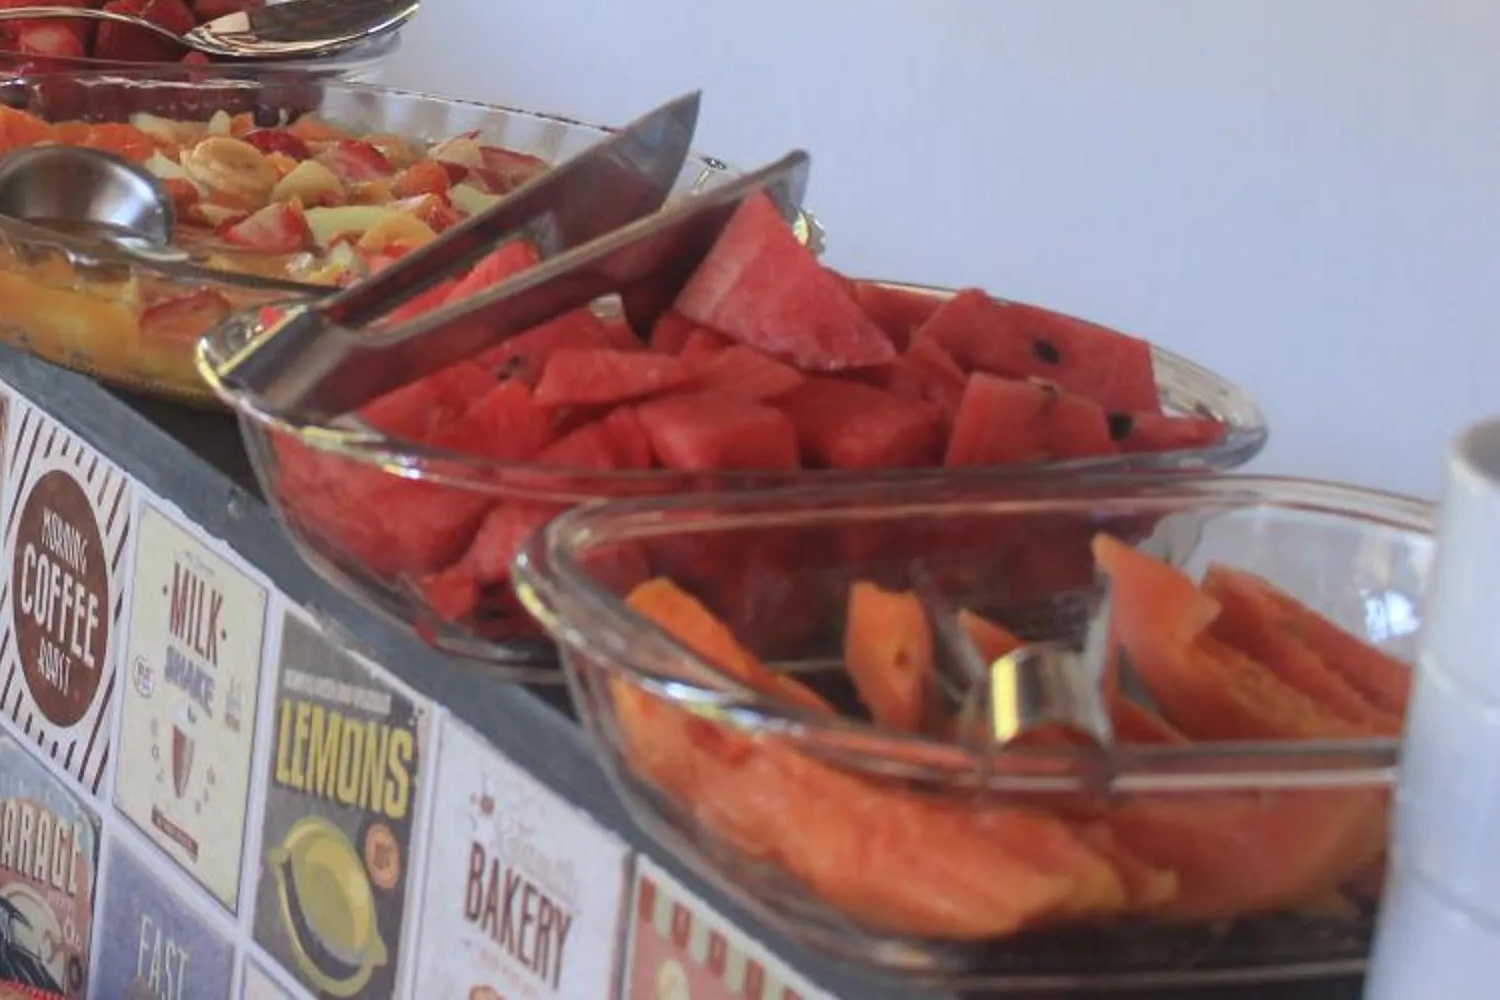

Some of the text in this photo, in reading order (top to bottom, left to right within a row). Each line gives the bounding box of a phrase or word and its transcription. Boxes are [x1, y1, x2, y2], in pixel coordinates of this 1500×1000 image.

[41, 507, 88, 576] MORNING
[20, 542, 99, 669] COFFEE
[169, 561, 223, 669] MILK
[37, 636, 72, 696] ROAST
[276, 696, 413, 819] LEMONS
[138, 913, 189, 1000] FAST
[464, 840, 573, 992] BAKERY
